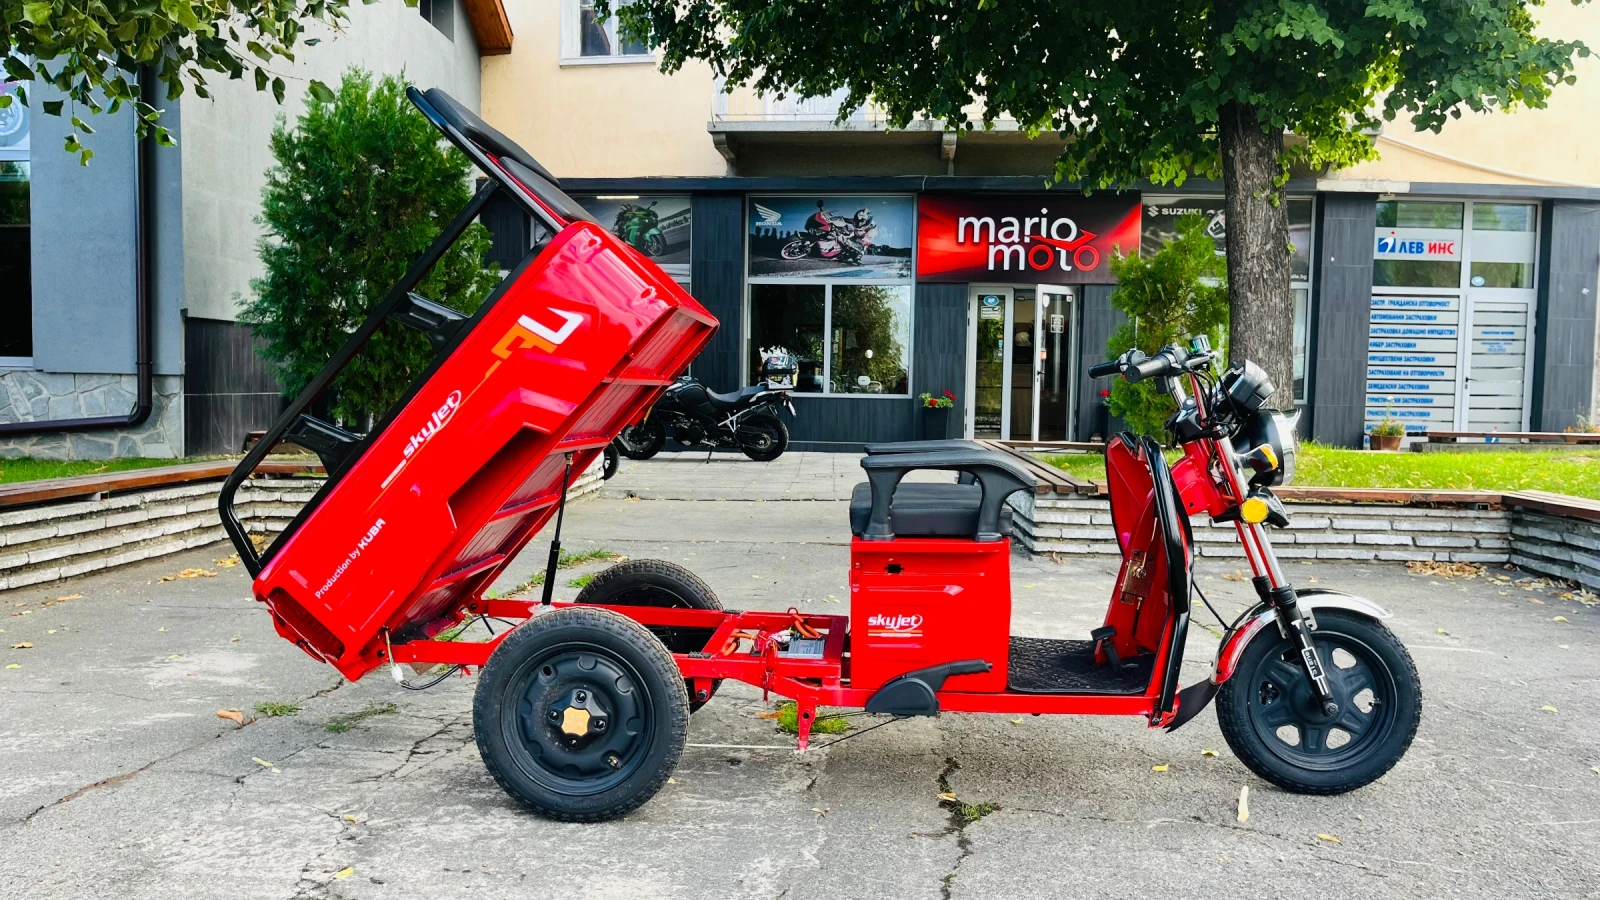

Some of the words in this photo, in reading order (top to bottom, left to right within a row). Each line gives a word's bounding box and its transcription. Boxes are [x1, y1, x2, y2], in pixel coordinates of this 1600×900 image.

[957, 207, 1078, 243] mario
[1161, 208, 1203, 216] SUZUKI
[987, 243, 1100, 272] moto
[1399, 241, 1424, 254] ЛЕВ
[1428, 242, 1454, 255] ИНС
[403, 390, 462, 459] skyjet
[314, 558, 352, 599] Production
[348, 548, 361, 560] by
[357, 518, 386, 550] KUBA
[867, 613, 923, 631] skyjet
